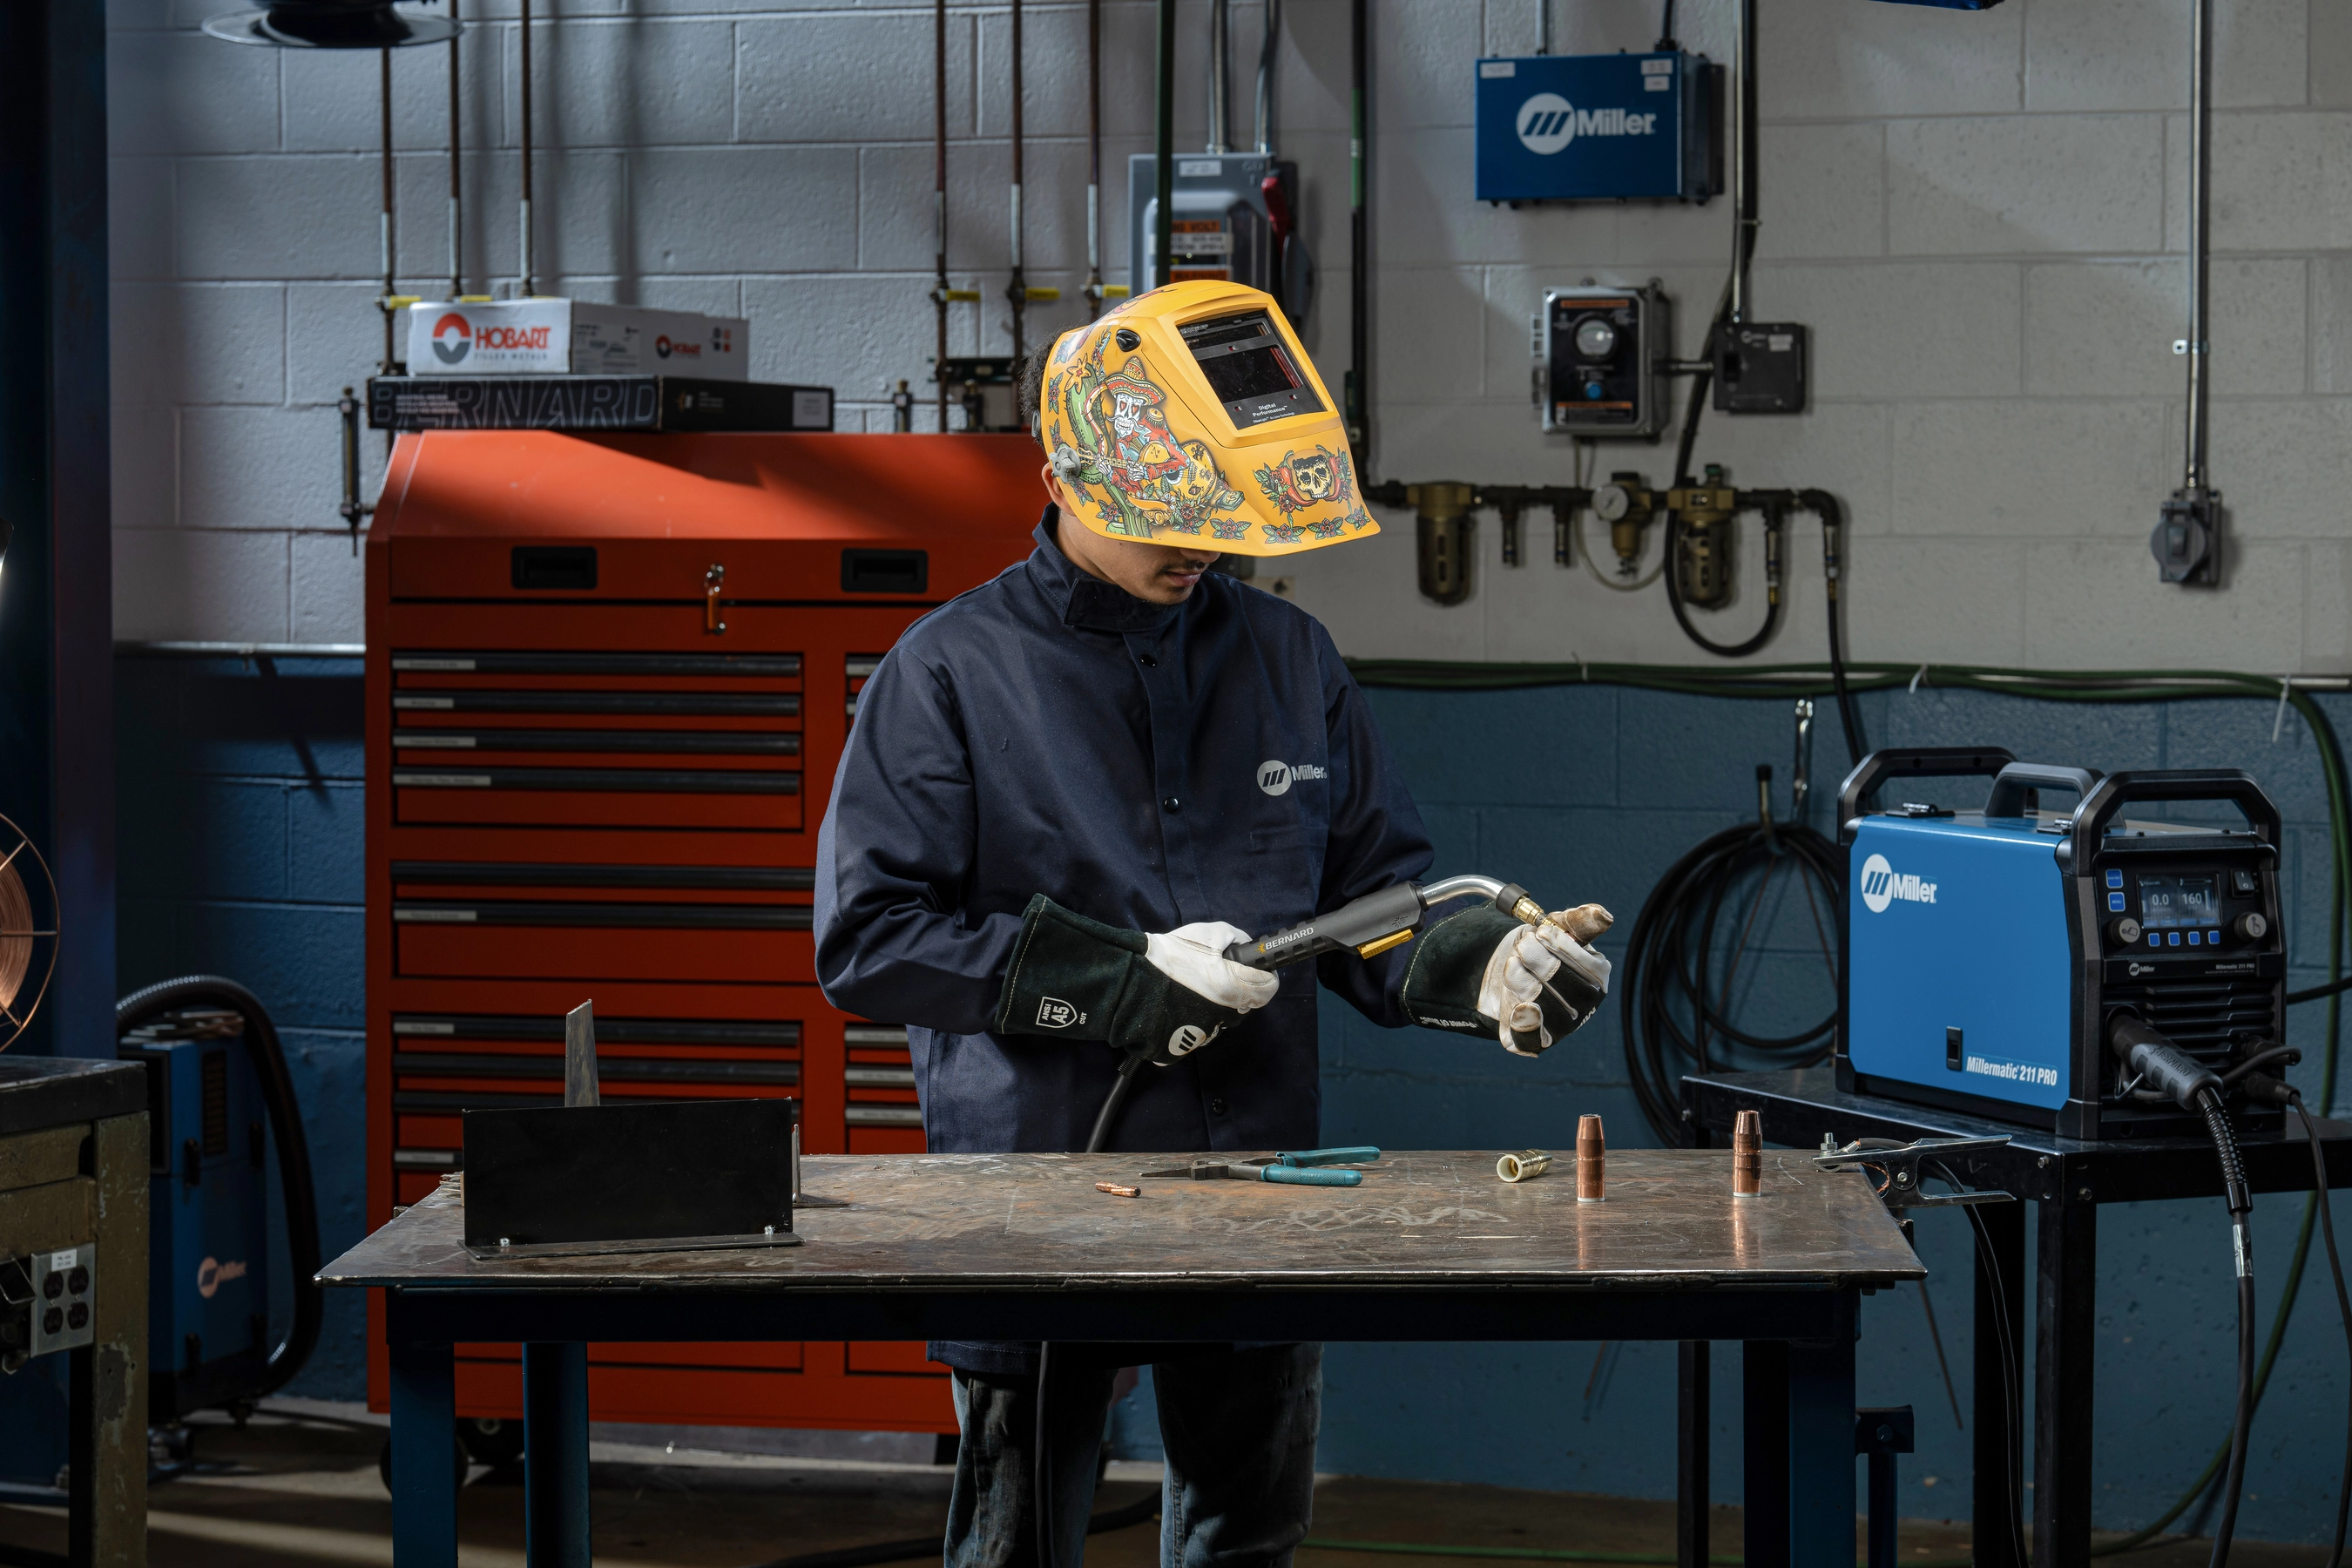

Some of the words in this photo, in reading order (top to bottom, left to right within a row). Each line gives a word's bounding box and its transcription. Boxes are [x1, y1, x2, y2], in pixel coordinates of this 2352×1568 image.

[1577, 108, 1656, 136] Miller
[476, 327, 551, 349] HOBART
[1290, 764, 1326, 781] Miller
[1893, 873, 1937, 904] Miller
[2152, 894, 2169, 905] 0.0
[2182, 893, 2202, 905] 160
[1265, 927, 1315, 950] BERNARD
[1041, 1004, 1052, 1021] ANSI
[1051, 1005, 1070, 1024] A5
[1078, 1011, 1087, 1024] CUT
[1966, 1056, 2018, 1080] Millermatic
[2019, 1064, 2036, 1082] 211
[2037, 1069, 2058, 1086] PRO
